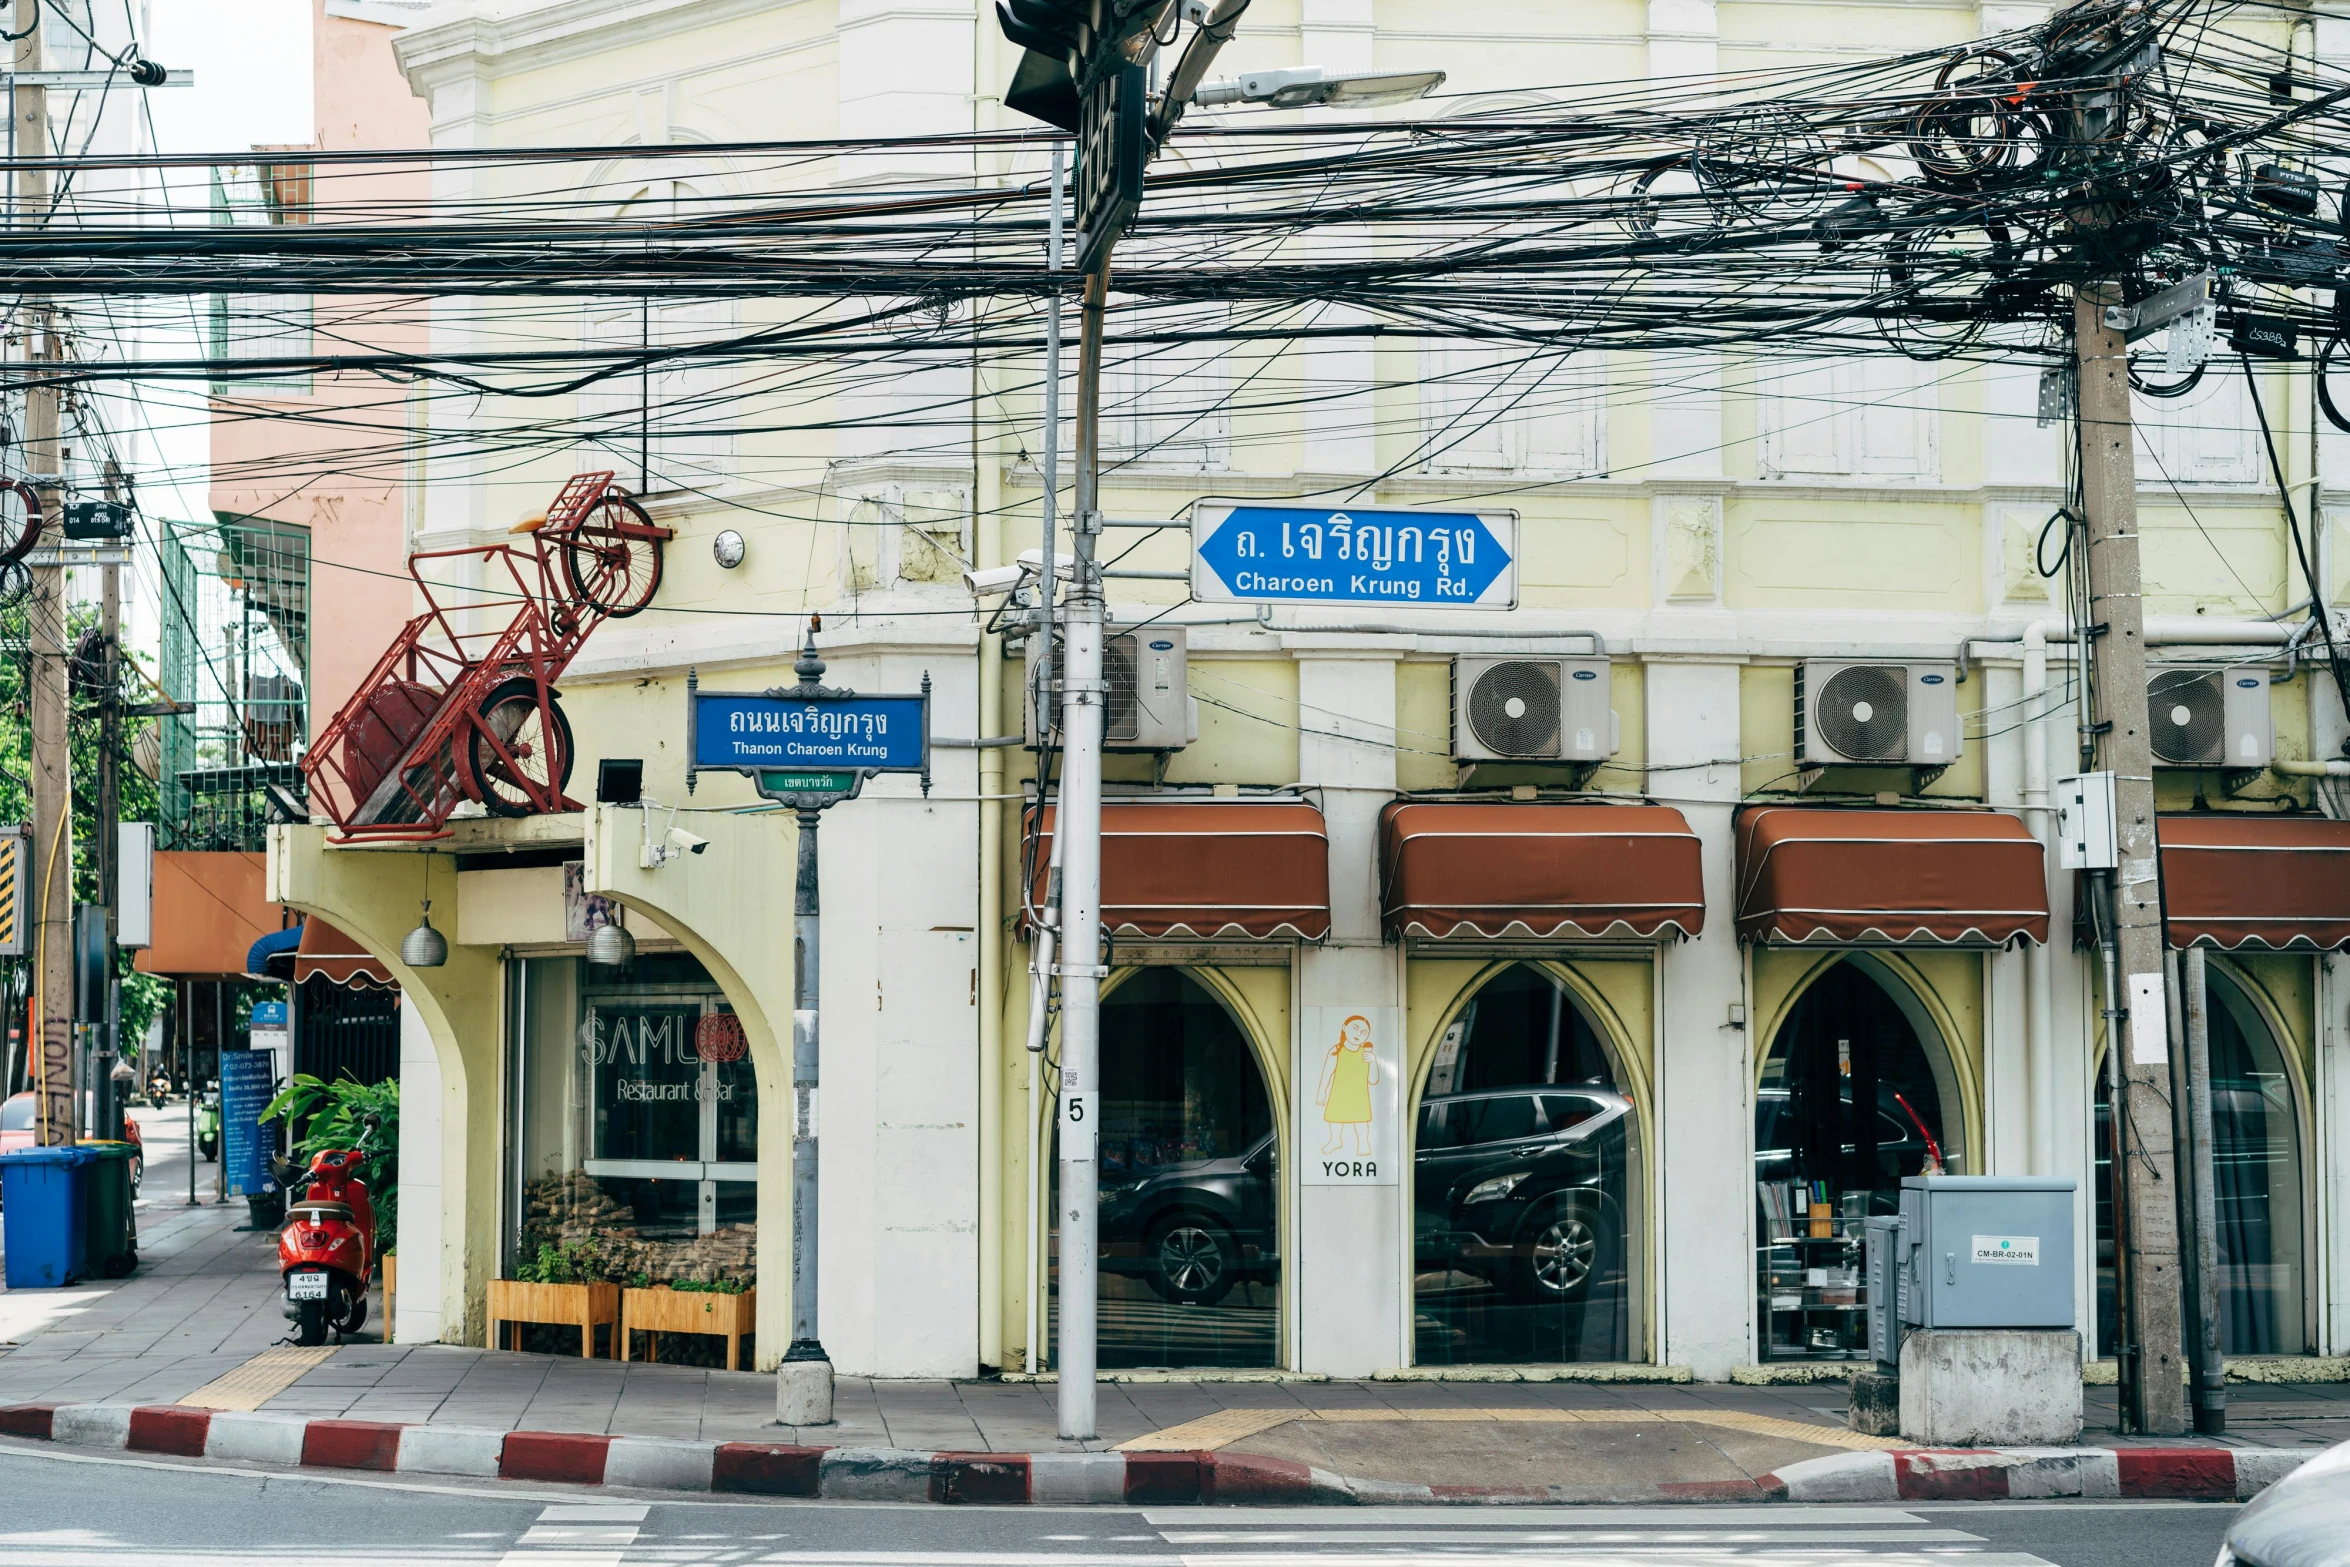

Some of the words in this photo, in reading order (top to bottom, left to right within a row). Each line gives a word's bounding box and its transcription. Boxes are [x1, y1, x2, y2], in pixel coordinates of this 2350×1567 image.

[1236, 531, 1265, 558] ถ.
[1282, 512, 1475, 576] เจริญกรุง
[1236, 572, 1334, 593] Charoen
[1351, 575, 1421, 598] Krung
[1436, 577, 1474, 597] Rd.
[730, 705, 887, 742] ถนนเจริญกรุง
[732, 742, 782, 755] Thanon
[787, 742, 843, 756] Charoen
[847, 743, 888, 759] Krung
[784, 774, 833, 788] เขตบางรัก
[617, 1078, 690, 1101] Restaurant
[693, 1078, 707, 1101] &
[713, 1079, 735, 1101] Bar
[1069, 1097, 1084, 1122] 5
[1322, 1161, 1377, 1177] YORA
[1977, 1249, 2033, 1259] CM-BR-02-01N
